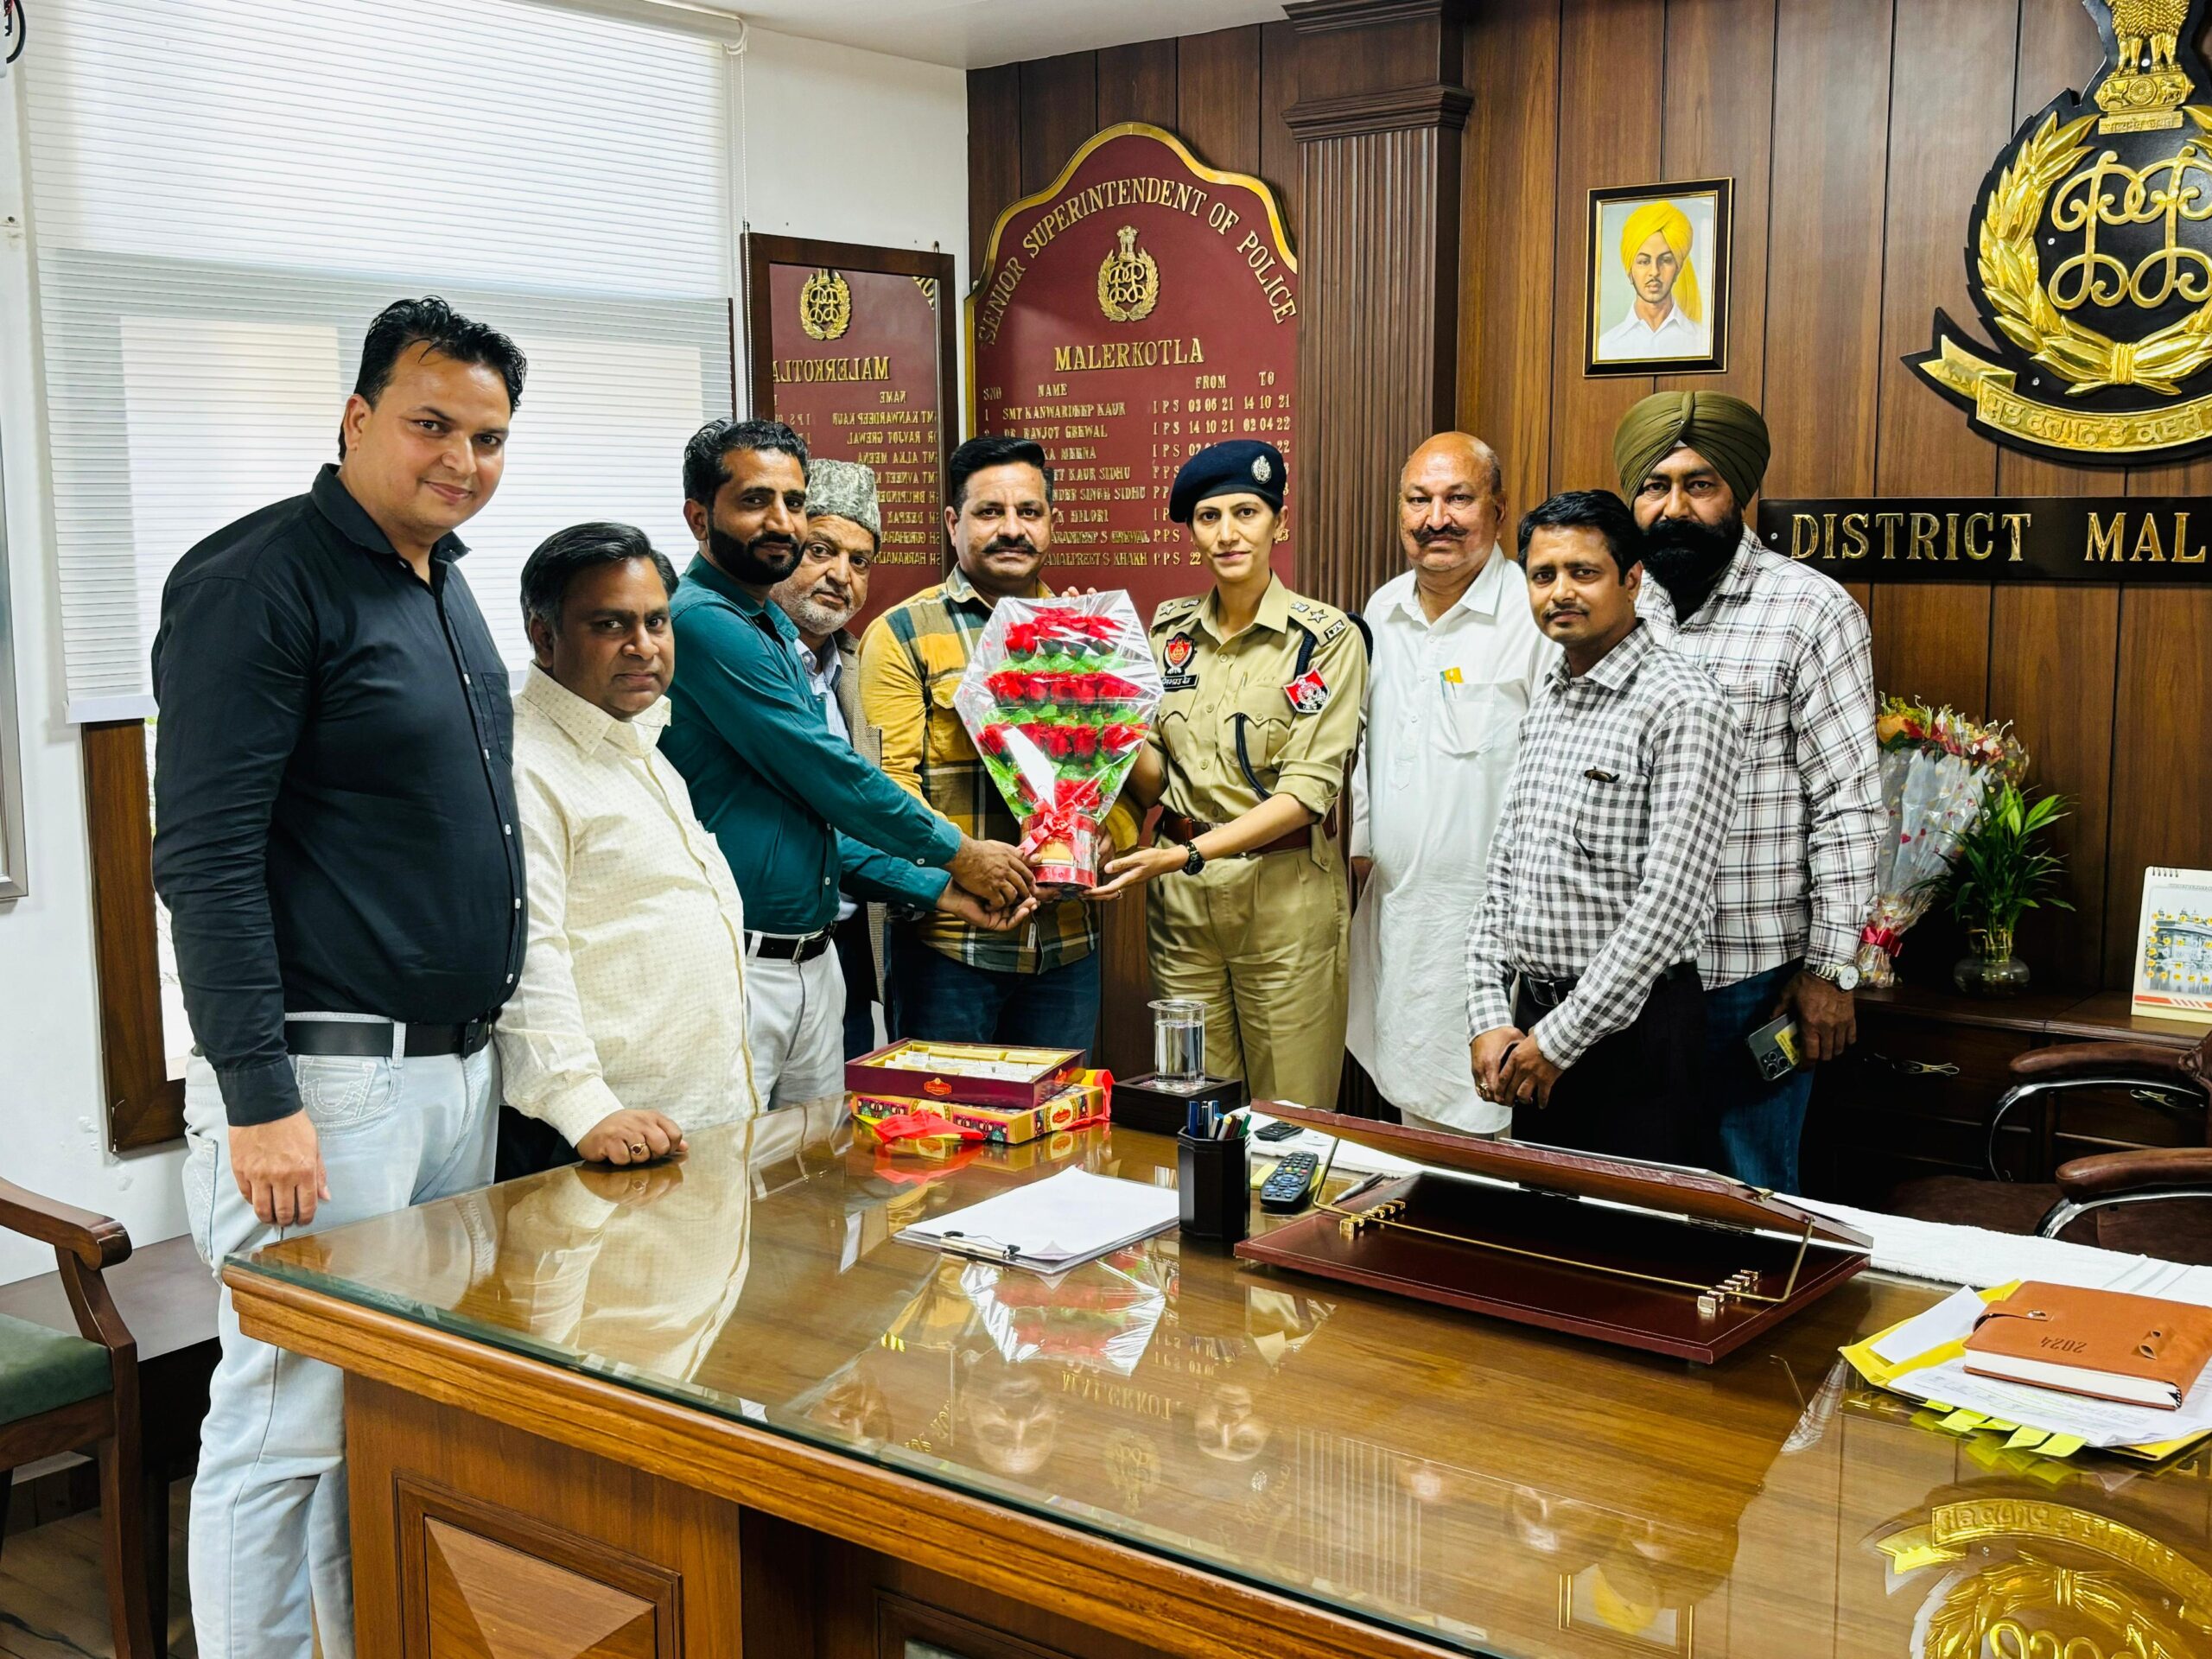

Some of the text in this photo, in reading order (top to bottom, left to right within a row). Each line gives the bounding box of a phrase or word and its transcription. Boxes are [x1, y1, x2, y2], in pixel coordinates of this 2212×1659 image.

[979, 176, 1298, 345] SENIOR SUPERINTENDENT OF POLICE
[1054, 338, 1204, 372] MALERKOTLA
[1038, 383, 1068, 397] NAME
[1195, 375, 1227, 390] FROM
[1258, 372, 1274, 386] TO
[1096, 402, 1127, 416] KAUR
[1023, 426, 1060, 440] RAVJOT
[1065, 424, 1108, 439] GREWAL
[1276, 416, 1290, 430] 22
[1061, 447, 1096, 460] MEENA
[1068, 468, 1096, 481] KAUR
[1098, 467, 1131, 480] SIDHU
[1080, 487, 1110, 501] SINGH
[1114, 486, 1146, 499] SIDHU
[1790, 512, 2206, 563] DISTRICT MAL
[1114, 552, 1147, 566] KHAKH
[2040, 1336, 2088, 1354] 2024
